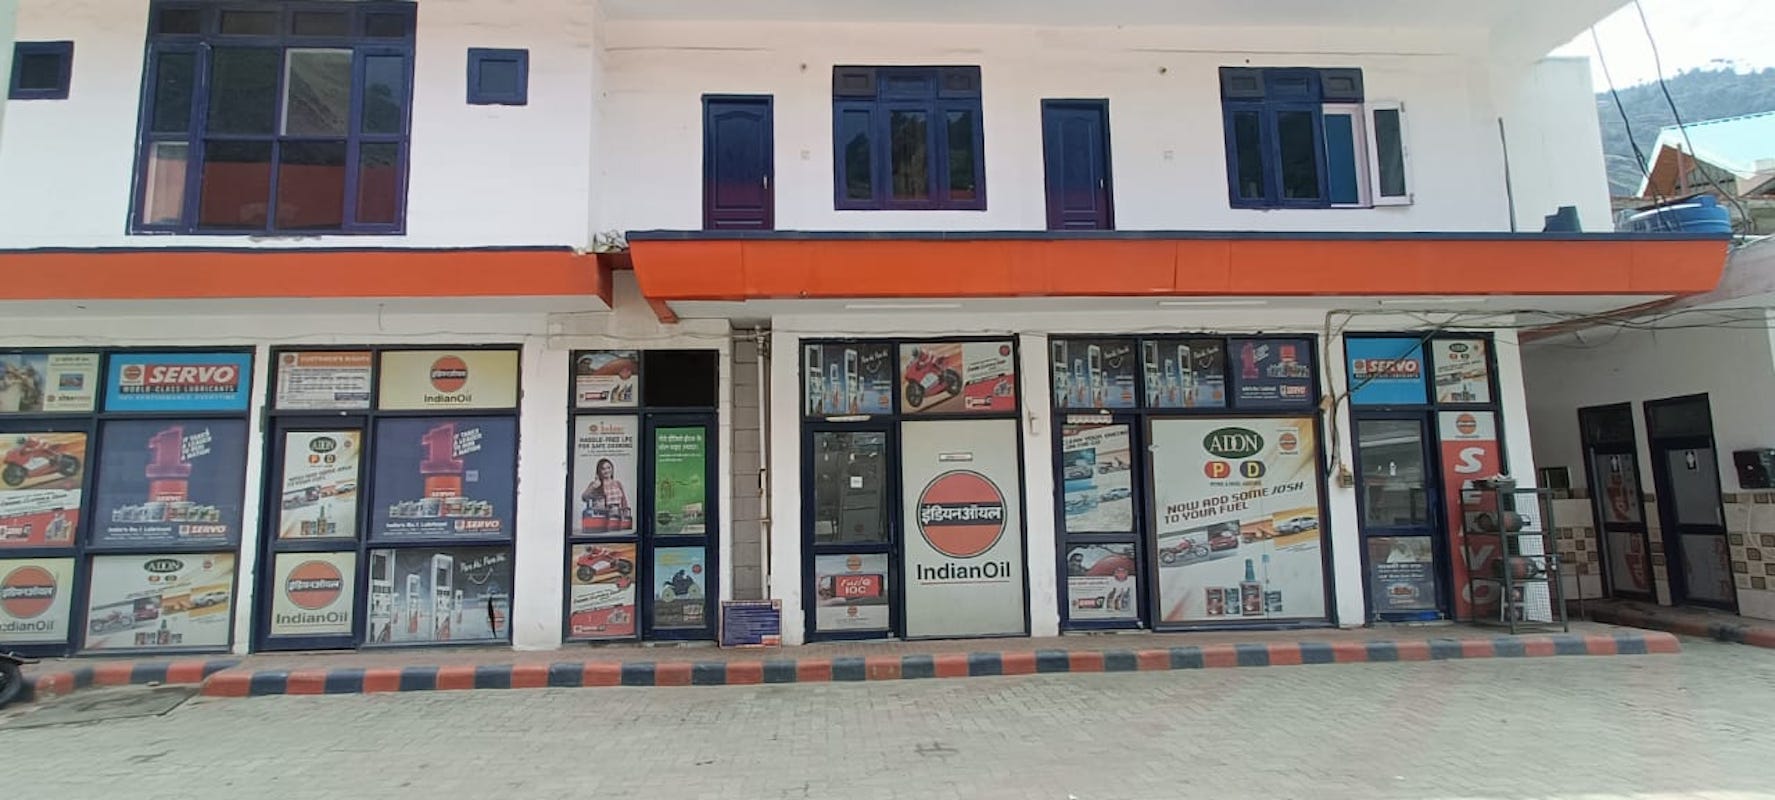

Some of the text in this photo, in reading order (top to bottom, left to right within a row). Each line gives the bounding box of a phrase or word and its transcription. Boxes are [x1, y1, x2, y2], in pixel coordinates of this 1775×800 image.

[149, 365, 235, 384] SERVO
[423, 394, 473, 403] IndianOil
[1209, 434, 1258, 453] ADON
[1212, 463, 1260, 478] P D
[1166, 481, 1304, 515] NOW ADD SOME JOSH
[922, 504, 1002, 524] इंडियनऑयल
[1164, 501, 1249, 525] TO YOUR FUEL
[466, 520, 500, 528] SERVO
[917, 561, 1010, 580] IndianOil
[276, 611, 348, 624] IndianOil
